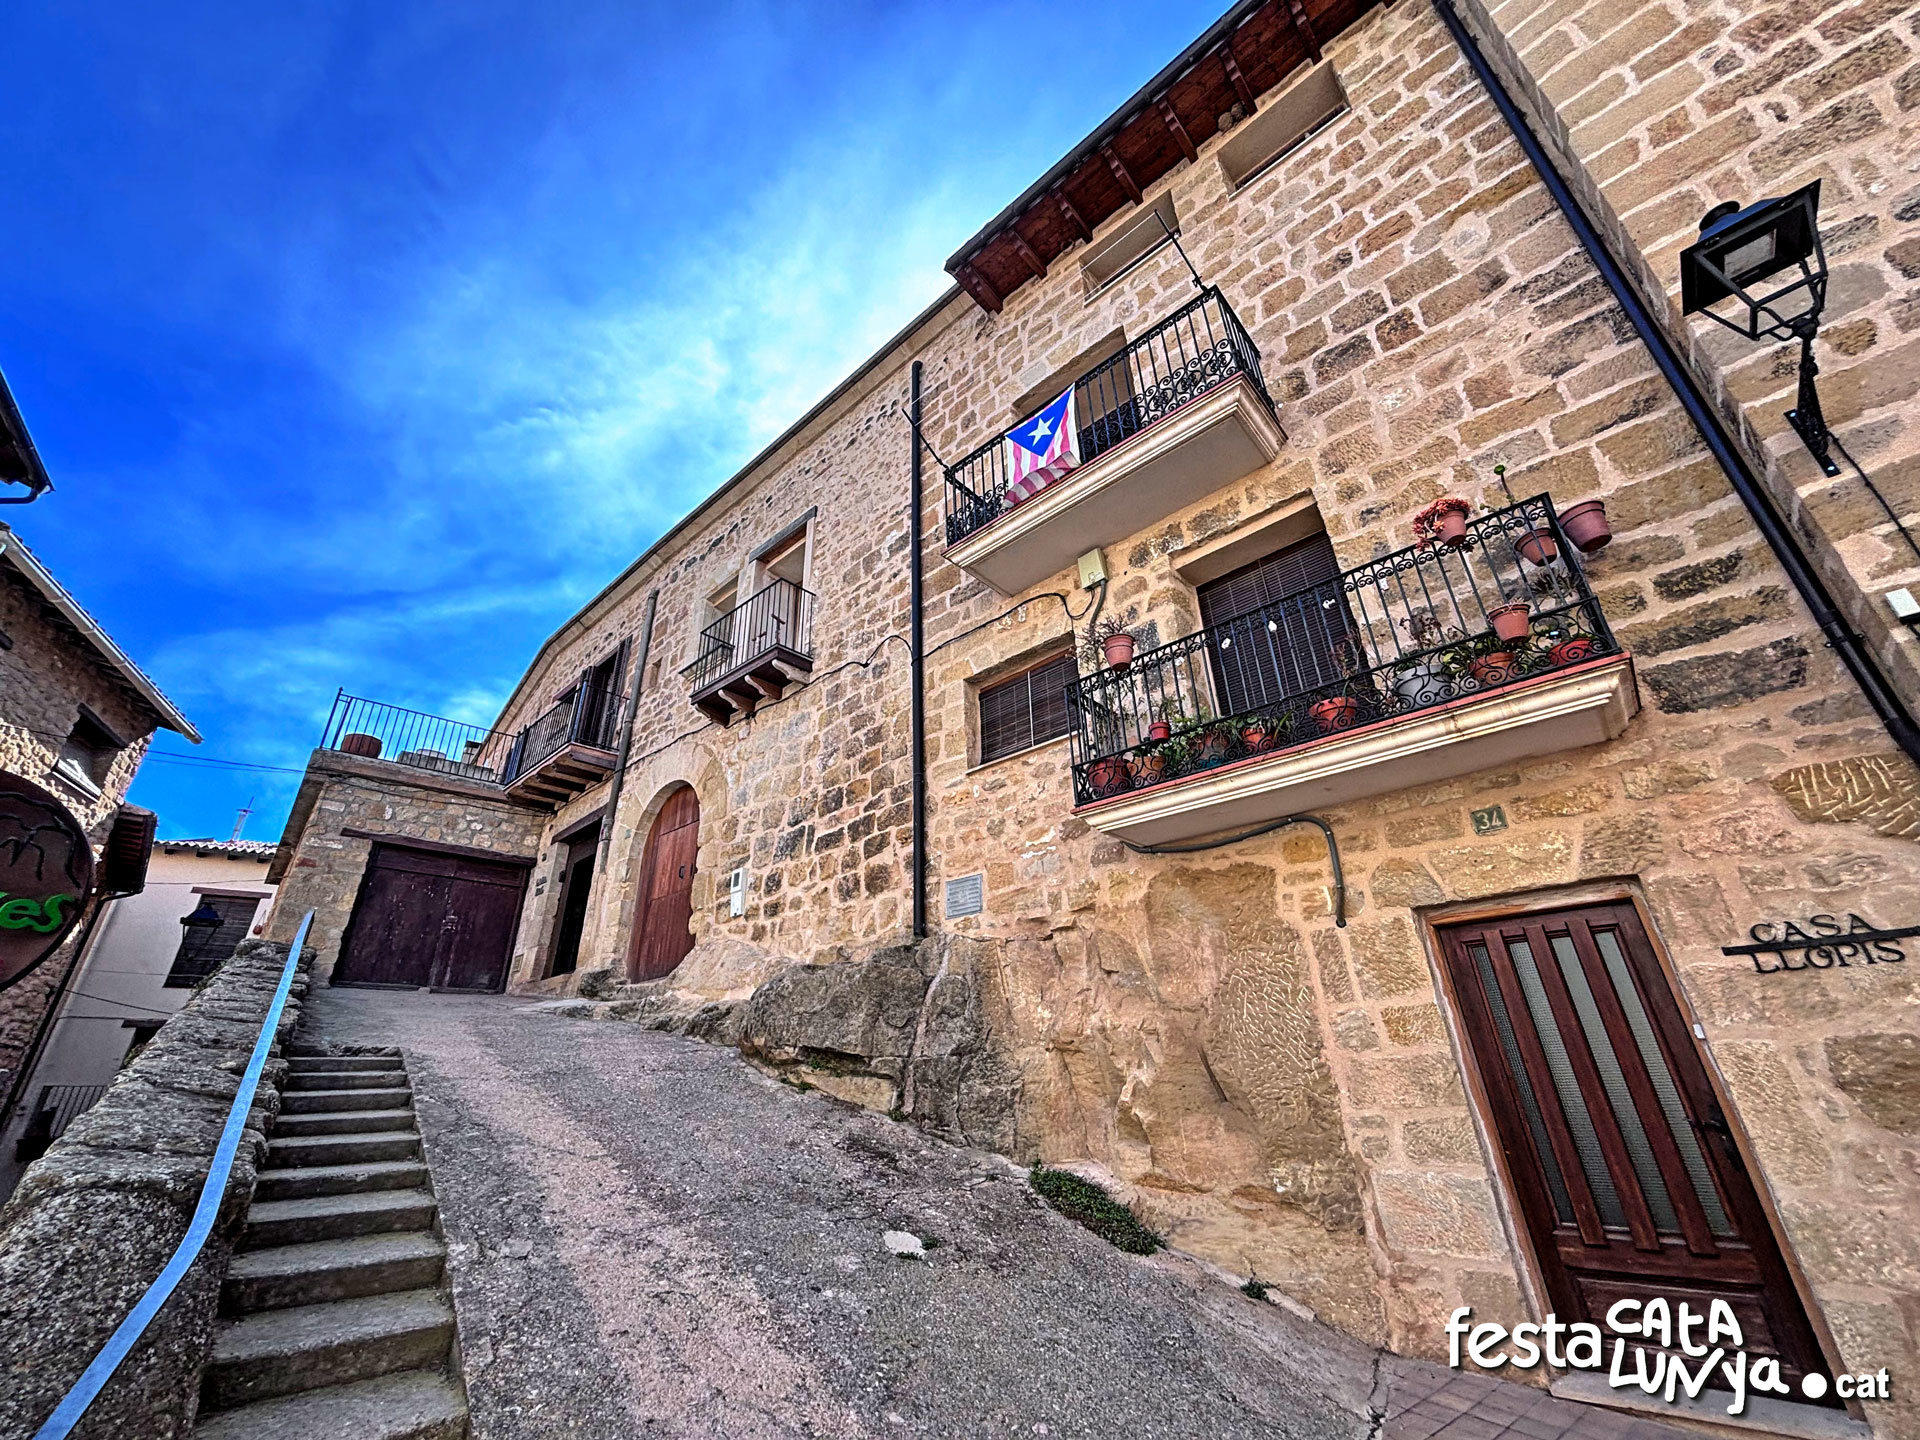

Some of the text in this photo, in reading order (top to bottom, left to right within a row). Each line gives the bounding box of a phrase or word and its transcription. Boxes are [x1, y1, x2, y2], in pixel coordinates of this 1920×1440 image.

[1477, 810, 1502, 829] 34
[1750, 913, 1881, 944] CASA
[1750, 938, 1906, 974] LLOPIS
